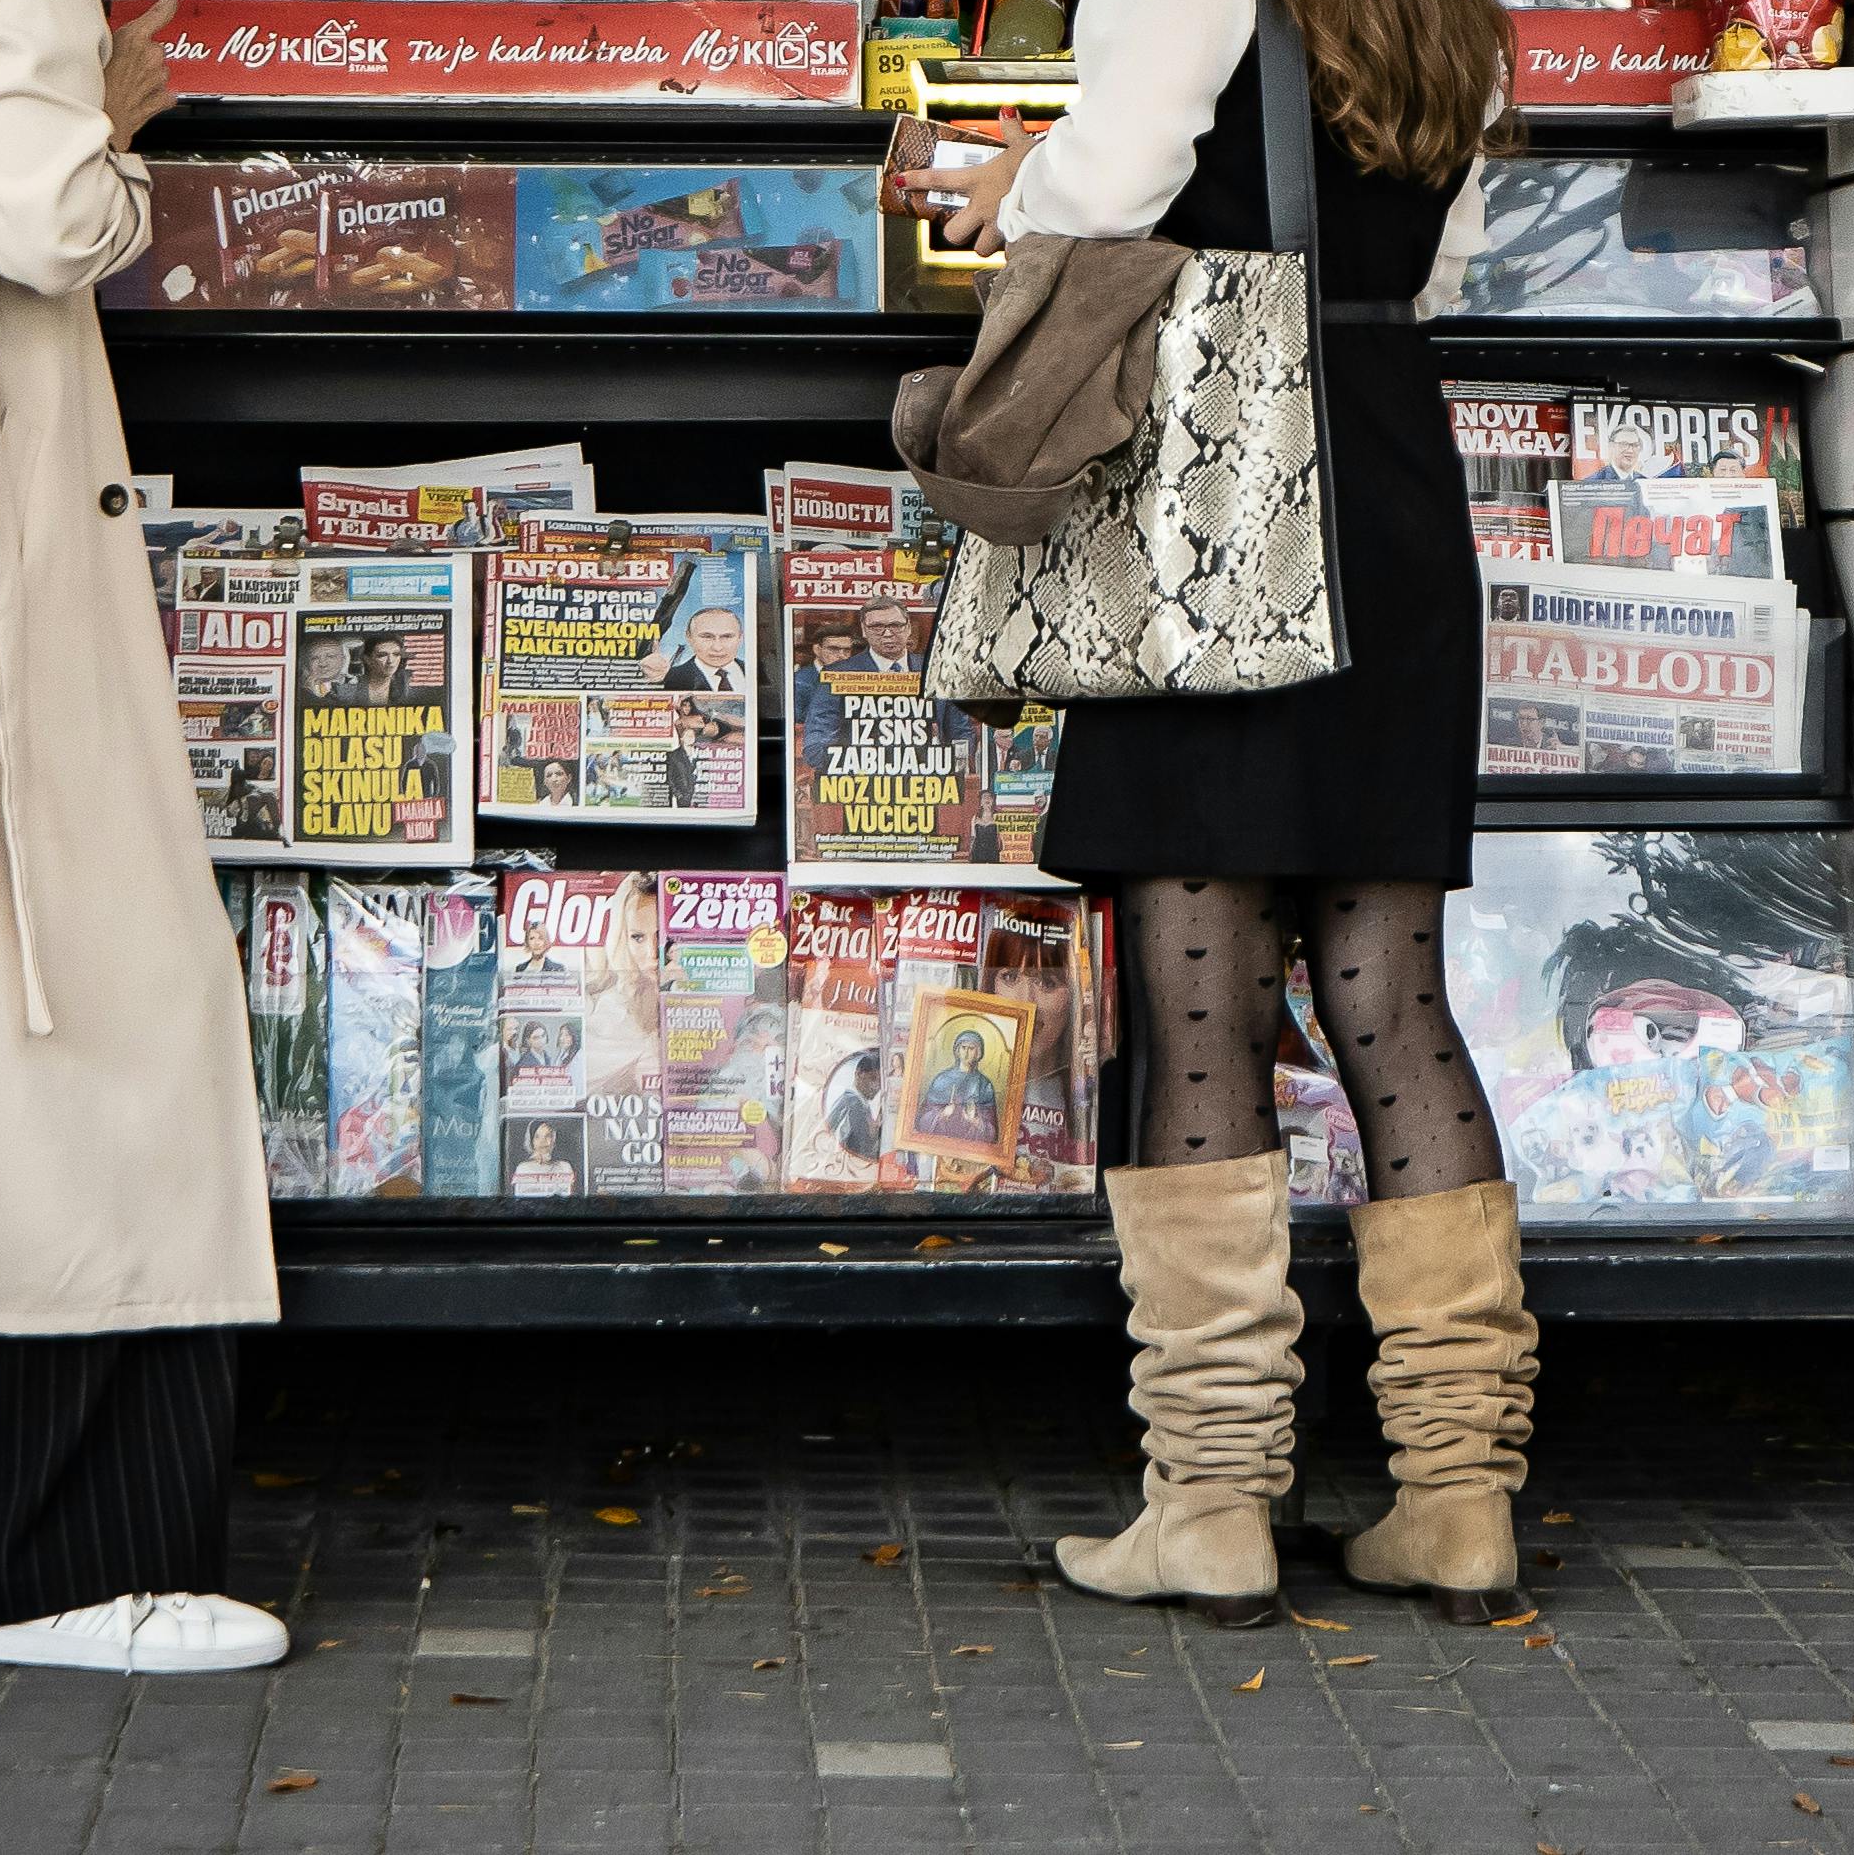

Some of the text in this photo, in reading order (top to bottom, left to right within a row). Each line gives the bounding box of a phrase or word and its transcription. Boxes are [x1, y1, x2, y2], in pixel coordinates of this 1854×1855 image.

[1769, 9, 1809, 20] CLASSIC
[218, 25, 278, 65] Moj
[407, 29, 740, 74] Tu je kad mi treba Moj
[348, 62, 389, 73] ŠTAMPA
[810, 67, 849, 76] ŠTAMPA
[878, 55, 905, 73] 89
[1529, 43, 1712, 83] Tu je kad mi
[880, 86, 912, 95] AKCIJA
[337, 196, 445, 234] plazma
[621, 215, 653, 238] No
[603, 220, 679, 251] Sugar
[715, 252, 751, 273] No
[697, 269, 772, 294] Sugar
[1455, 403, 1539, 429] NOVI
[1573, 403, 1761, 466] EKSPRES
[317, 491, 410, 519] Srpski
[793, 500, 891, 524] НОВОСТИ
[1590, 507, 1742, 560] Печат
[790, 557, 884, 578] Srpski
[229, 578, 288, 592] NA KOSOVU
[506, 584, 657, 606] Putin sprema
[262, 591, 296, 604] LAZAR
[506, 602, 656, 622] udar na Kijev
[1532, 593, 1736, 639] BUĐENJE PACOVA
[201, 612, 285, 649] Alo!
[505, 619, 661, 639] SVEMIRSKOM
[505, 638, 637, 656] RAKETOM?!
[1504, 635, 1773, 699] TABLOID
[845, 696, 934, 719] PACOVI
[304, 706, 444, 736] MARINIKA
[851, 721, 926, 745] IZ SNS
[304, 736, 403, 770] ĐILASU
[828, 747, 952, 775] ZABIJAJU
[1487, 748, 1579, 769] MAFIJA PROTIV
[304, 769, 425, 802] SKINULA
[874, 777, 892, 804] U
[893, 777, 960, 805] LEĐA
[304, 802, 392, 836] GLAVU
[700, 882, 777, 898] srećna
[682, 956, 748, 967] 14 DANA DO
[666, 1008, 721, 1018] KAKO DA
[587, 1095, 644, 1118] OVO
[667, 1121, 745, 1133] MENOPAUZA
